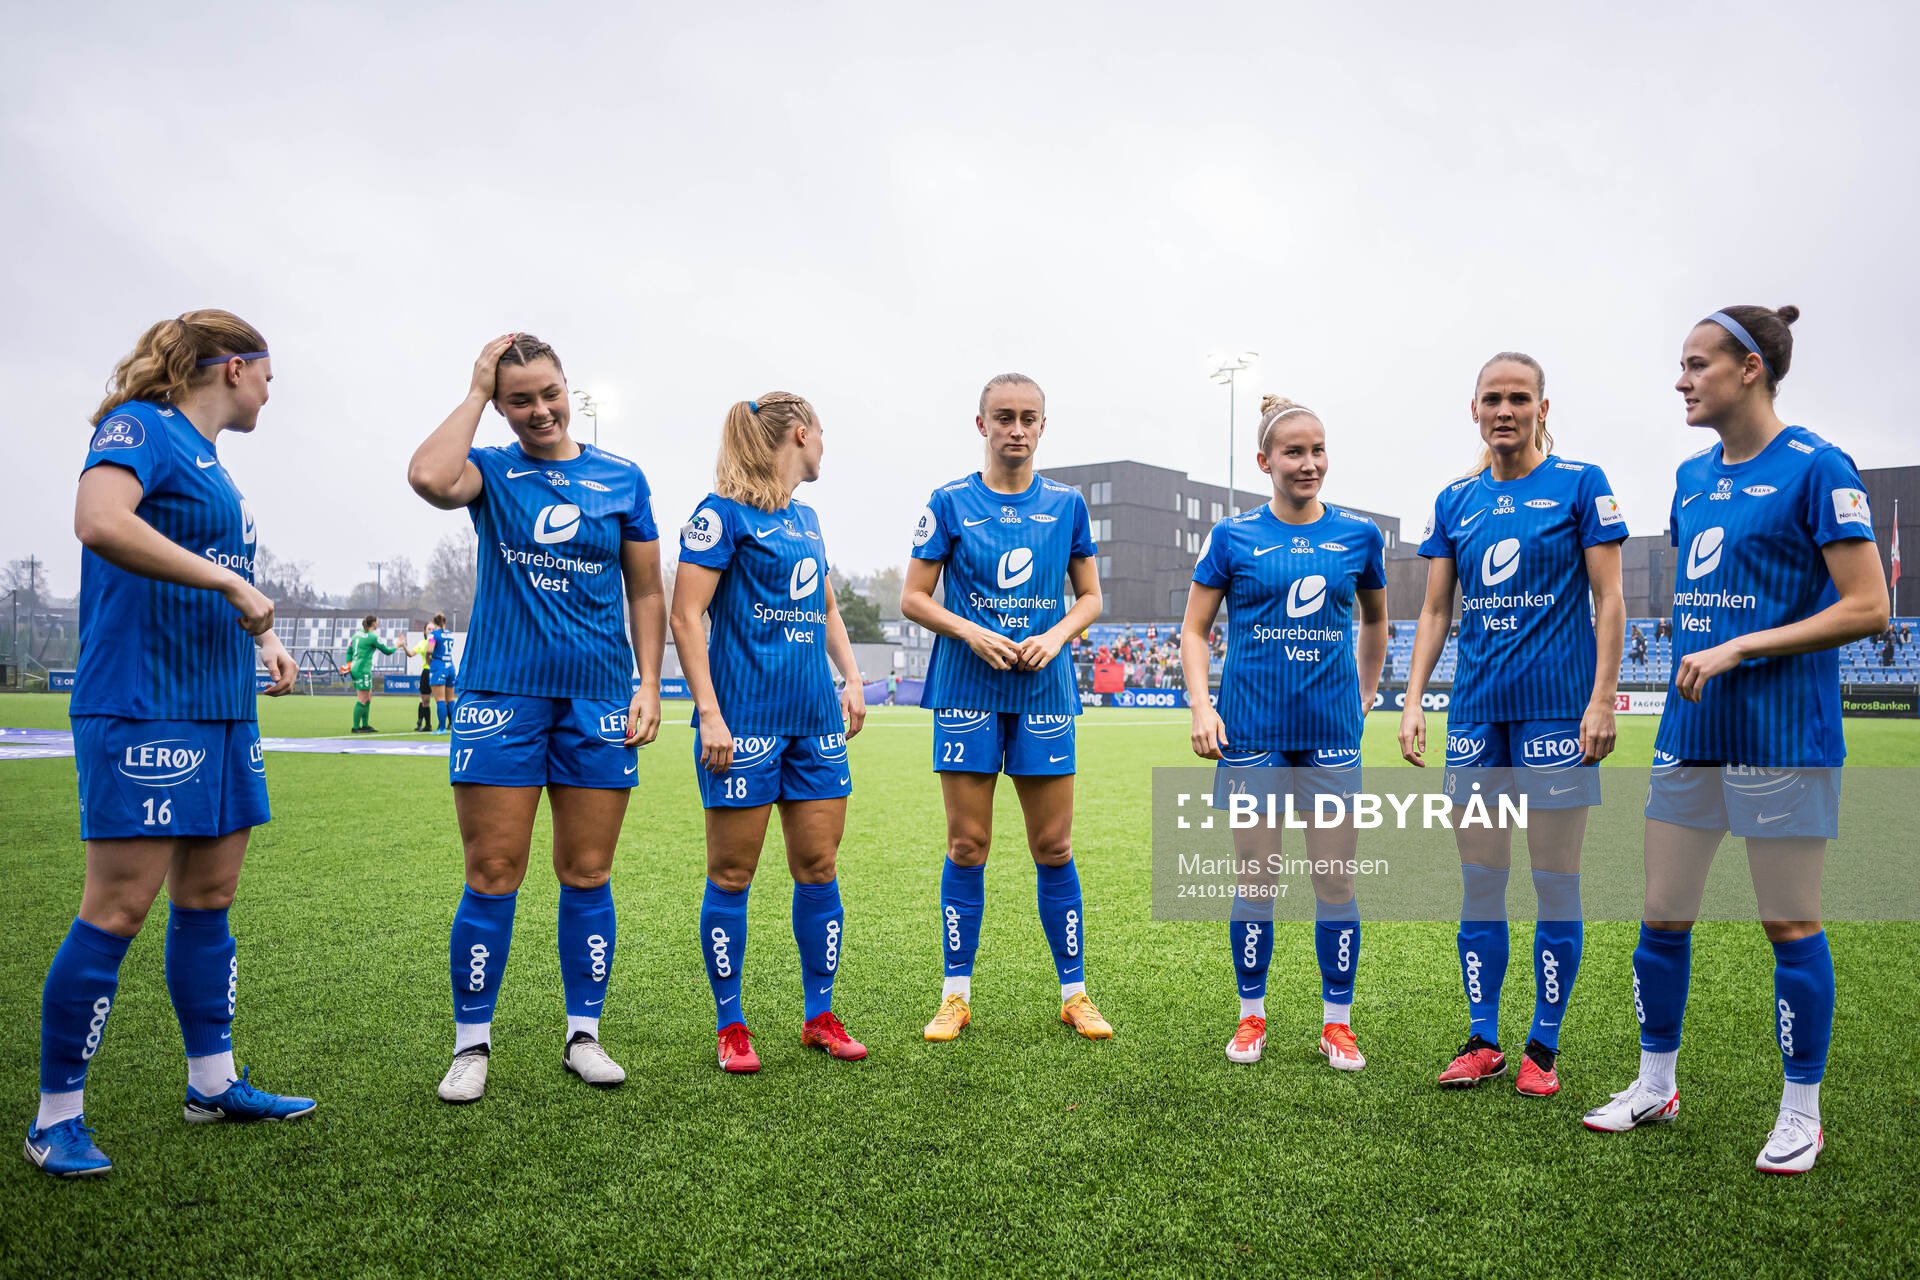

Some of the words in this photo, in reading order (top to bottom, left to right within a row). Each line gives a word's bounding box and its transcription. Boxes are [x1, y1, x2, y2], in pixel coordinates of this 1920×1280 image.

[97, 434, 133, 446] OBOS
[1709, 492, 1732, 501] OBOS
[1000, 516, 1022, 524] OBOS
[1493, 506, 1516, 516] OBOS
[687, 531, 712, 543] OBOS
[500, 542, 603, 575] Sparebanken
[529, 571, 570, 593] Vest
[969, 592, 1057, 610] Sparebanken
[1673, 587, 1756, 609] arebanken
[997, 613, 1030, 629] Vest
[1482, 614, 1518, 631] Vest
[1681, 612, 1712, 633] Vest
[784, 626, 814, 644] Vest
[1252, 624, 1344, 644] Sparebanken
[1284, 645, 1321, 662] Vest
[1136, 692, 1175, 707] OBOS
[1842, 700, 1911, 711] RørosBanken
[455, 706, 509, 726] LERØY
[600, 714, 628, 733] LER
[732, 737, 771, 754] RØY
[820, 732, 846, 751] LER
[943, 741, 965, 763] 22
[1447, 735, 1480, 754] ERØY
[125, 746, 202, 769] LERØY
[454, 748, 474, 773] 17
[723, 776, 748, 799] 18
[142, 798, 172, 825] 16
[945, 905, 960, 951] coop
[1066, 910, 1079, 957] coop
[711, 927, 731, 978] coop
[825, 919, 841, 972] coop
[1244, 922, 1262, 969] coop
[469, 943, 489, 992] coop
[586, 934, 607, 982] coop
[1465, 951, 1482, 1004] coop
[1541, 949, 1560, 1004] coop
[81, 996, 111, 1061] coop
[1779, 998, 1796, 1058] coop
